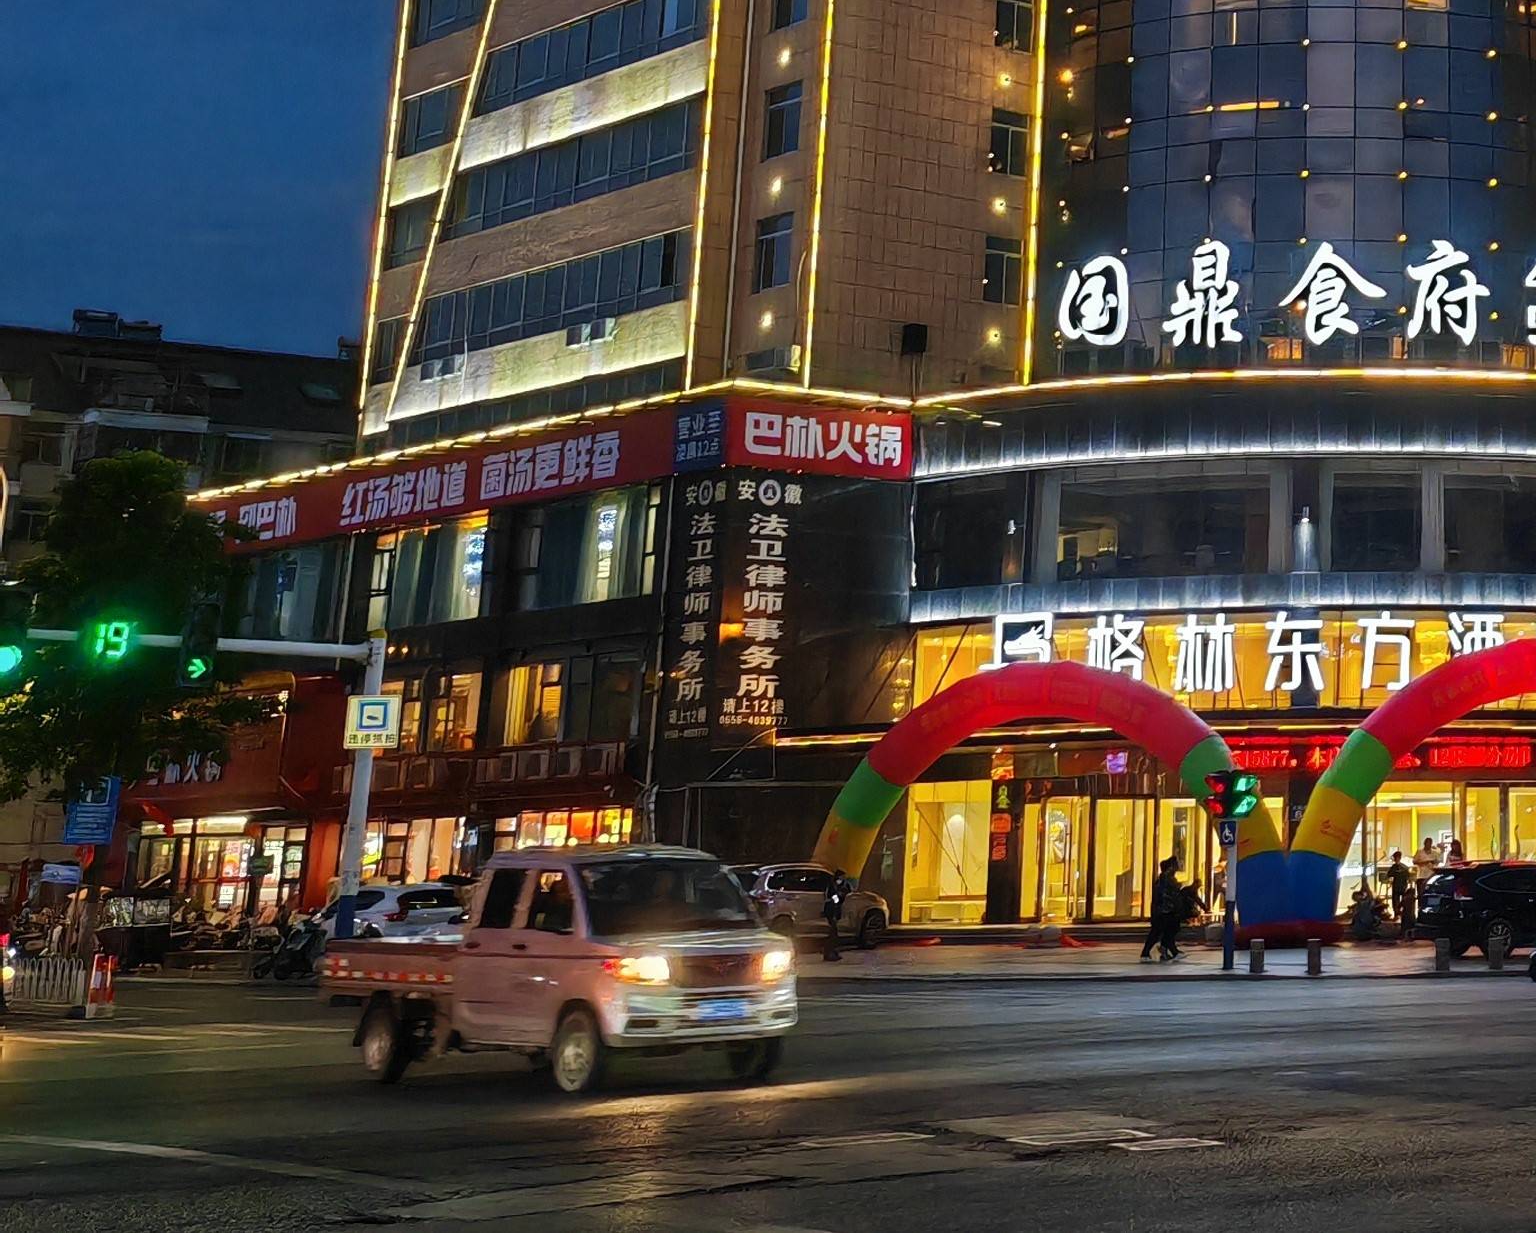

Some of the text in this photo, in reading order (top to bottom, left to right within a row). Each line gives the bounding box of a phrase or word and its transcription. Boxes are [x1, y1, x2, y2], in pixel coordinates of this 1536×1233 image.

[339, 430, 620, 526] 红汤够地道 菌汤更鲜香
[744, 411, 902, 467] 巴朴火锅
[95, 621, 129, 657] 19
[676, 512, 717, 702] 法卫律师事务所
[737, 513, 789, 698] 法卫律师事务所
